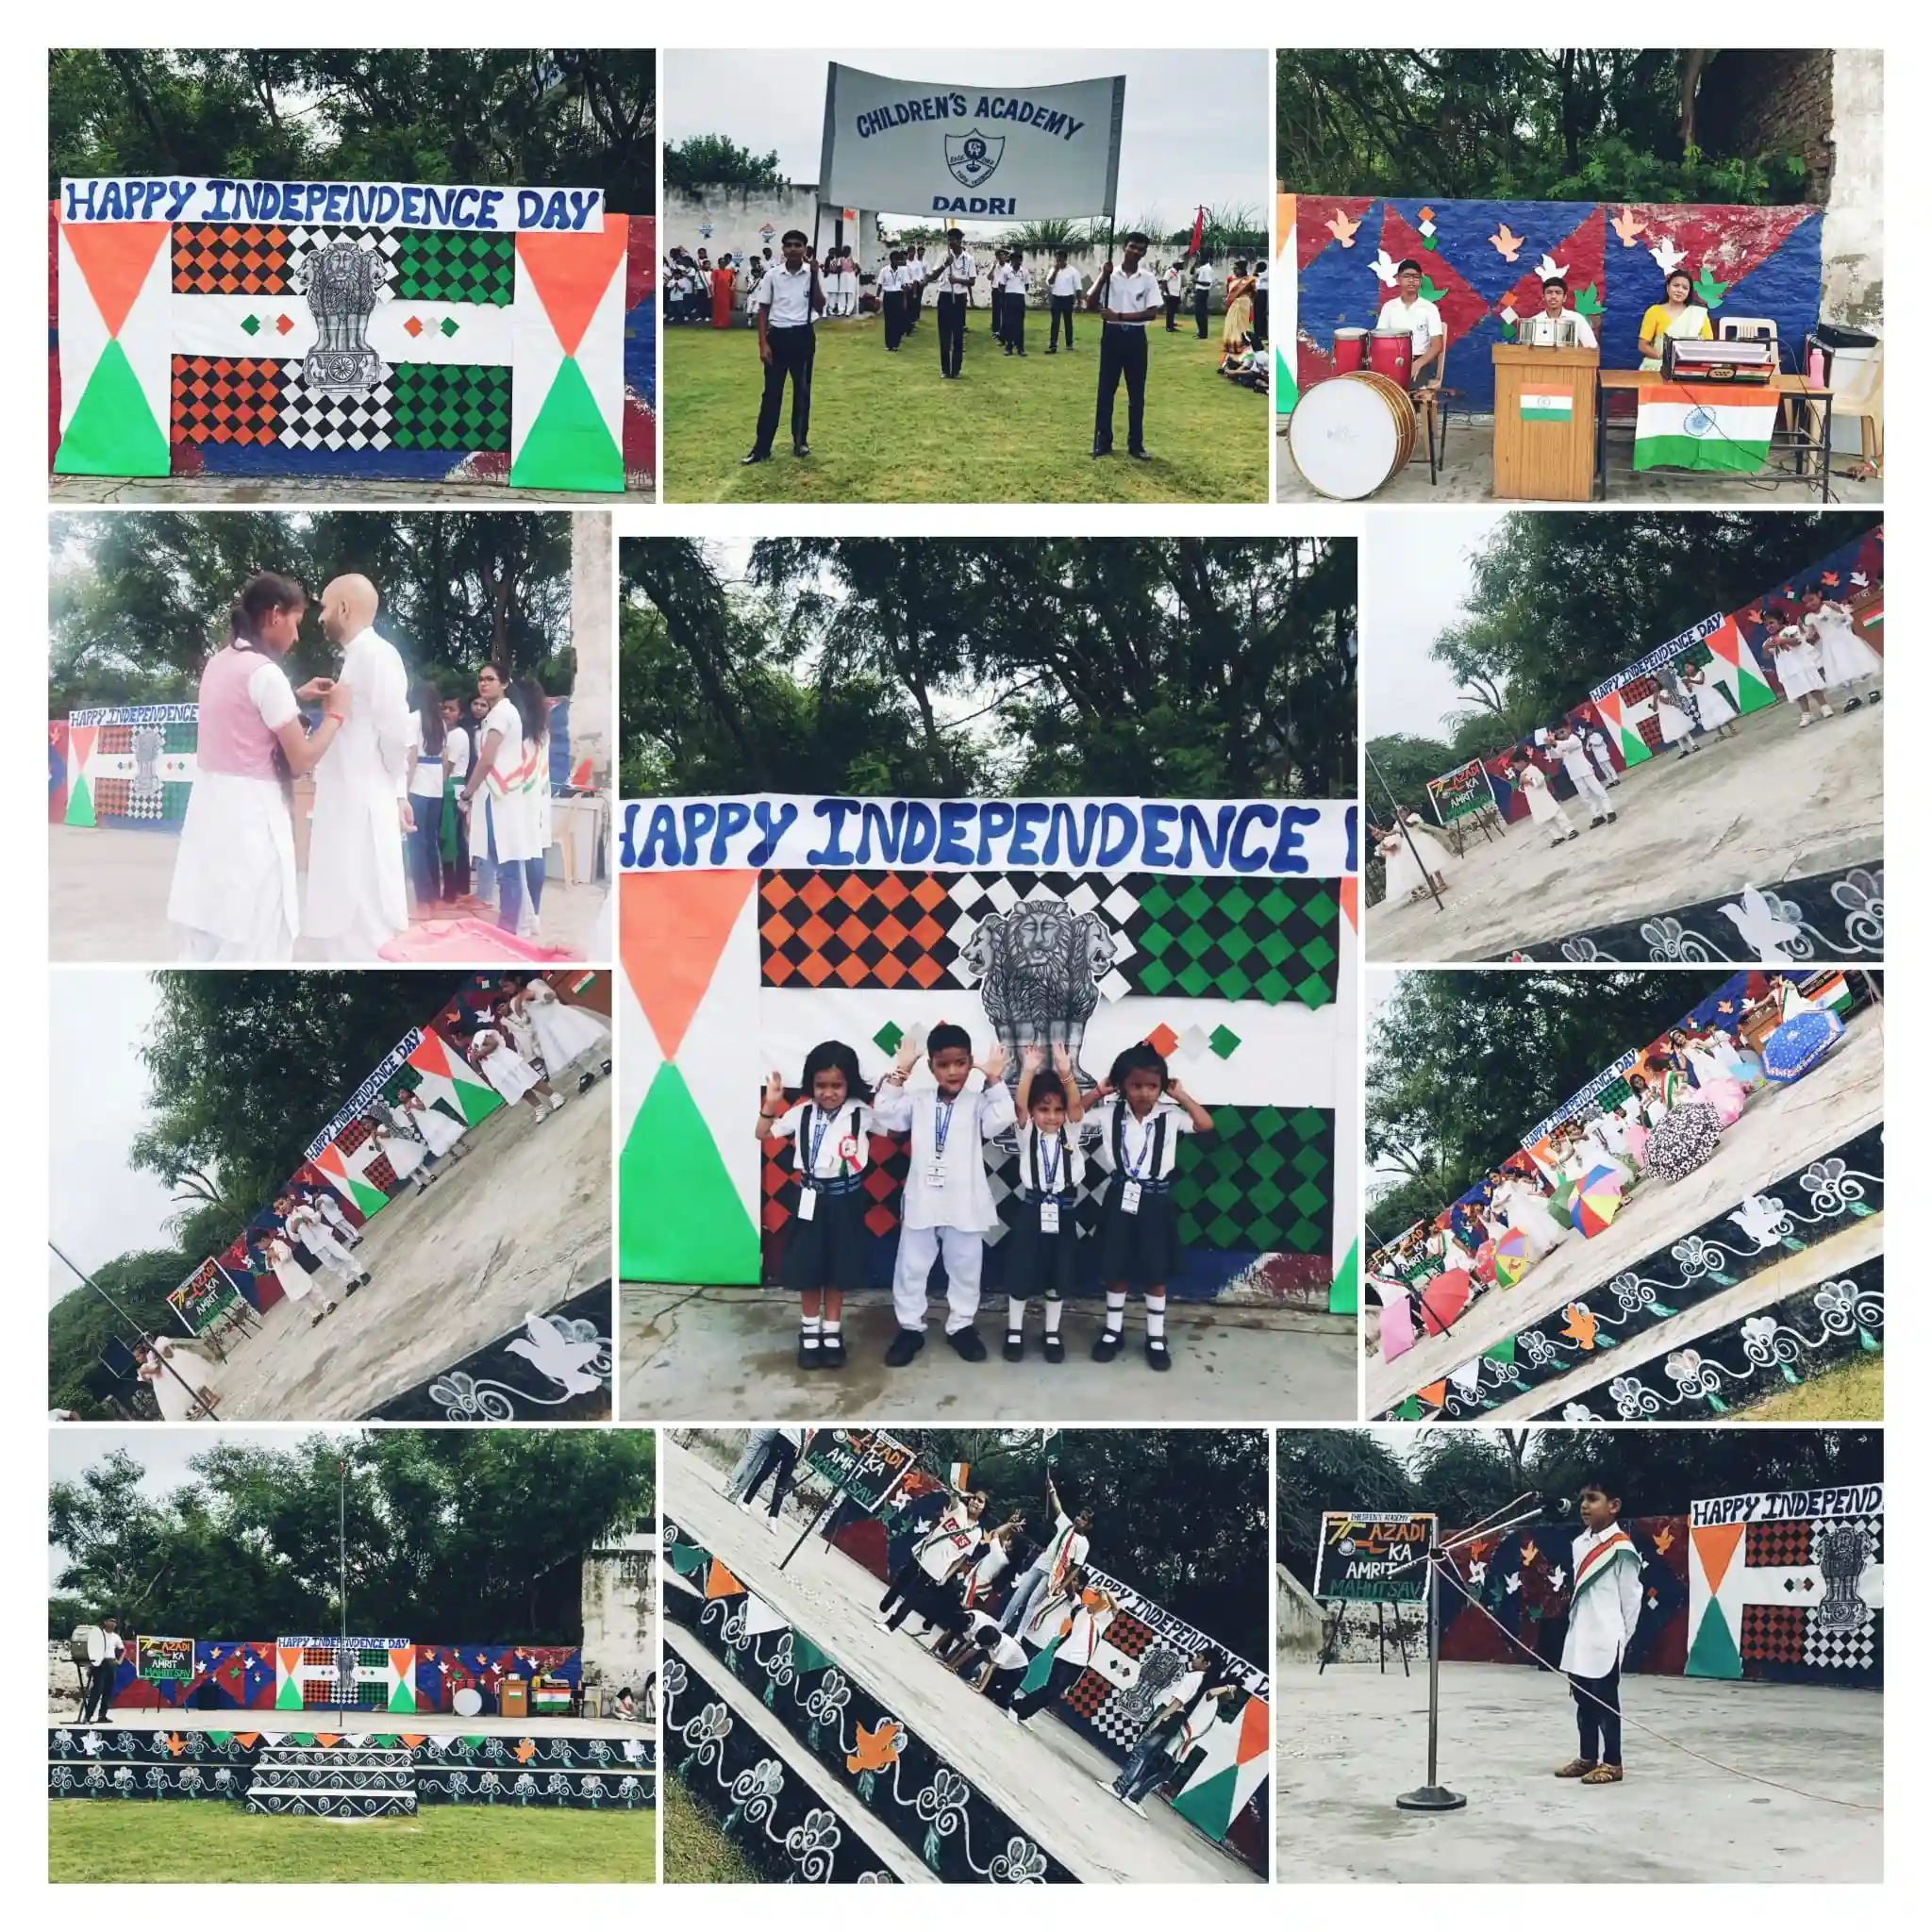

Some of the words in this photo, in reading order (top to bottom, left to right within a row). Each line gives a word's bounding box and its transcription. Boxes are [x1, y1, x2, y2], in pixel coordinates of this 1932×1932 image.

[857, 92, 967, 139] CHILDREN'S
[974, 96, 1085, 141] ACADEMY
[65, 180, 197, 221] HAPPY
[201, 180, 502, 229] INDEPENDENCE
[518, 189, 600, 230] DAY
[932, 196, 1017, 215] DADRI
[1591, 676, 1619, 701] HAPPY
[1622, 630, 1696, 684] INDEPENDENCE
[1697, 614, 1722, 637] DAY
[71, 709, 106, 726] HAPPY
[106, 705, 199, 724] INDEPENDENCE
[1465, 777, 1479, 789] KA
[807, 799, 1321, 874] INDEPENDENCE
[308, 1127, 332, 1161] HAPPY
[330, 1055, 399, 1132] INDEPENDENCE
[396, 1028, 421, 1059] DAY
[1522, 1122, 1548, 1149] HAPPY
[1549, 1068, 1616, 1128] INDEPENDENCE
[1615, 1049, 1637, 1074] DAY
[1414, 1240, 1426, 1253] KA
[205, 1277, 219, 1291] KA
[825, 1447, 870, 1479] AMRT
[865, 1453, 885, 1477] KA
[1693, 1496, 1759, 1526] HAPPY
[1761, 1486, 1883, 1520] INDEPEND
[1369, 1524, 1426, 1542] AZADI
[1388, 1542, 1412, 1561] KA
[1345, 1561, 1398, 1580] AMRIT
[162, 1642, 190, 1652] AZADI
[278, 1637, 309, 1647] HAPPY
[388, 1639, 408, 1649] DAY
[1124, 1595, 1257, 1687] INDEPENDNCE
[173, 1652, 185, 1660] KA
